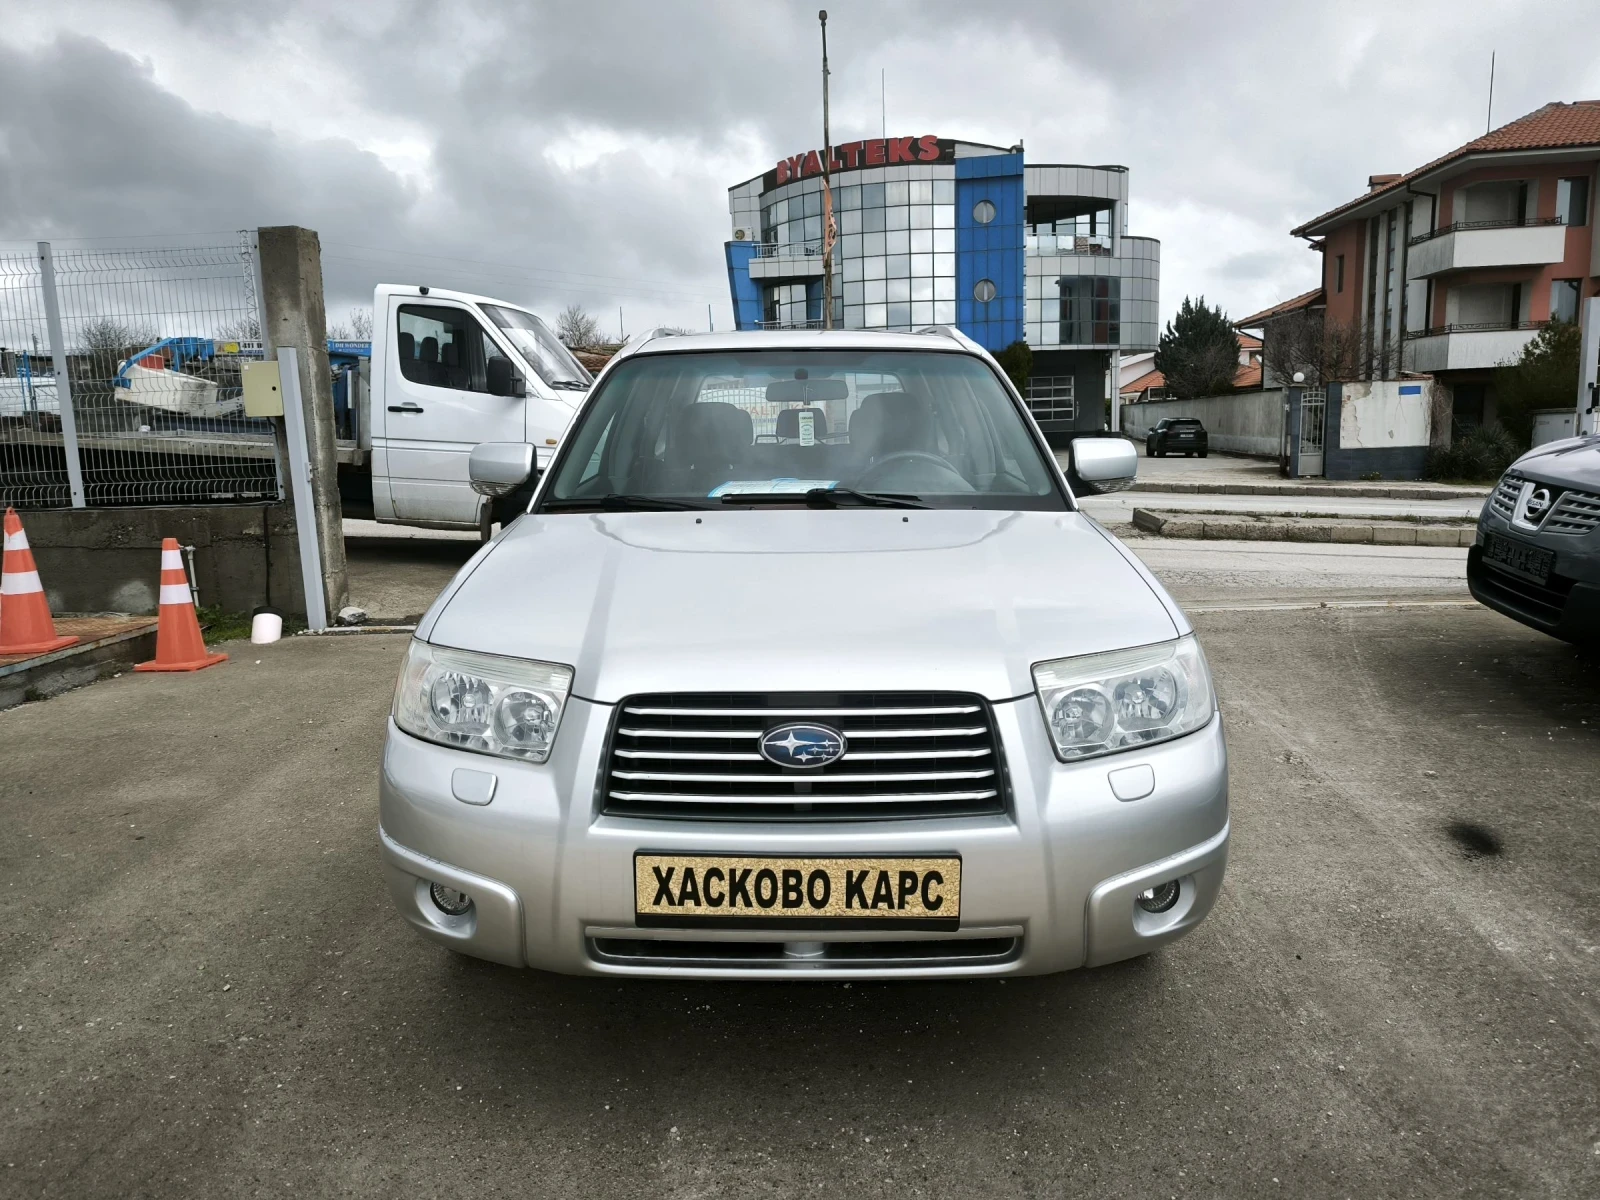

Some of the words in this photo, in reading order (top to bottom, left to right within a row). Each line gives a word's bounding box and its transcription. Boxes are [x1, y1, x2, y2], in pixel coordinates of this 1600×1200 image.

[776, 135, 940, 185] BYALTEKS
[652, 866, 831, 909] ХАСКОВО
[845, 870, 944, 911] КАРС
